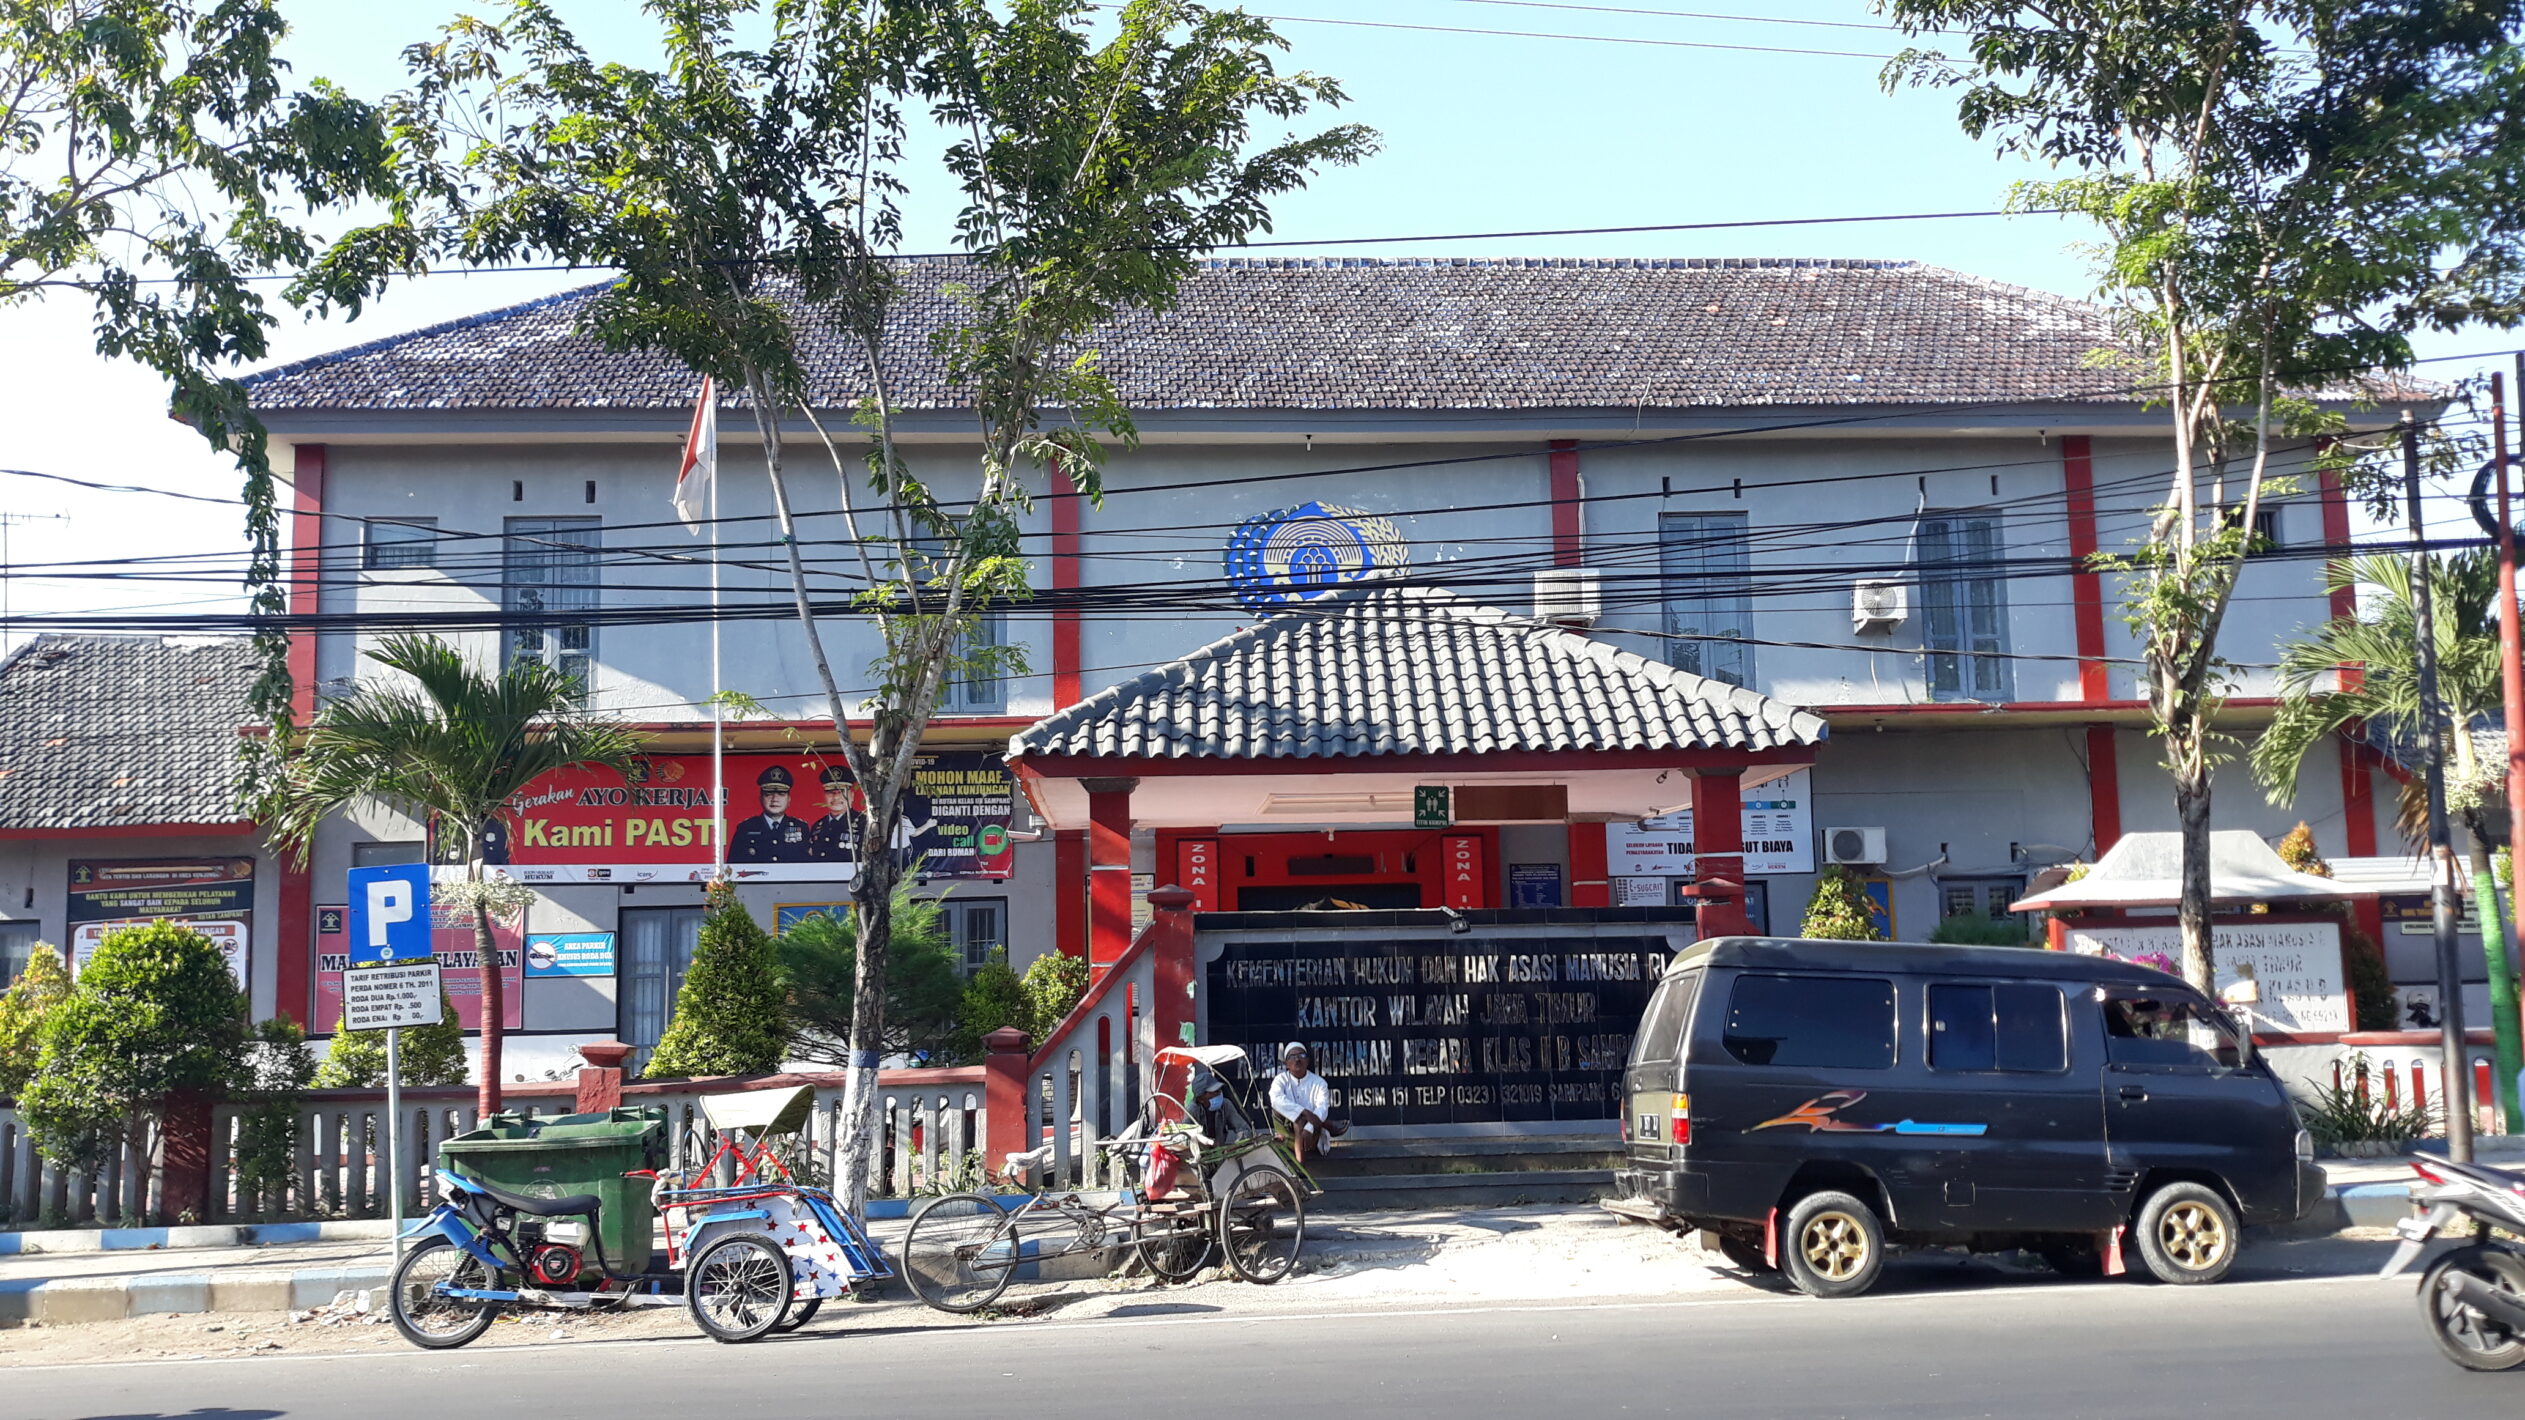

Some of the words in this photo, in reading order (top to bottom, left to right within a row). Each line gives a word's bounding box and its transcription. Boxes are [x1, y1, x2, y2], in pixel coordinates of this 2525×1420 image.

[916, 770, 964, 785] MOHON
[957, 785, 1010, 795] KUNJUNGAN
[512, 784, 575, 817] Gerakan
[576, 787, 628, 806] AYO
[931, 805, 971, 816] DIGANTI
[973, 805, 1010, 816] DENGAN
[524, 818, 613, 847] Kami
[937, 823, 969, 836] video
[953, 835, 975, 847] call
[1667, 842, 1695, 855] TIDA
[1762, 840, 1794, 853] BIAYA
[928, 848, 946, 857] DARI
[947, 848, 975, 856] RUMAH
[1191, 843, 1206, 886] ZONA
[1456, 840, 1471, 881] ZONA
[366, 880, 413, 947] P
[350, 973, 369, 982] TARIF
[371, 971, 406, 980] RETRIBUSI
[408, 969, 432, 977] PARKIR
[1226, 957, 1347, 989] KEMENTERIAN
[1353, 956, 1414, 985] HUKUM
[1422, 955, 1457, 984] DAN
[1464, 955, 1500, 984] HAK
[1508, 954, 1558, 983] ASASI
[1565, 953, 1641, 982] MANUSIA
[351, 984, 372, 992] PERDA
[374, 982, 398, 990] NOMER
[418, 980, 433, 988] 2011
[351, 995, 369, 1003] RODA
[351, 1005, 369, 1013] RODA
[371, 1003, 392, 1011] EMPAT
[1298, 996, 1376, 1029] KANTOR
[1387, 993, 1469, 1026] WILAYAH
[1480, 992, 1529, 1025] JAWA
[1534, 991, 1596, 1025] TIMUR
[352, 1016, 371, 1024] RODA
[1237, 1041, 1287, 1080] RUMA
[1310, 1039, 1392, 1077] TAHANAN
[1402, 1037, 1473, 1075] NEGARA
[1482, 1036, 1532, 1073] KLAS
[1556, 1034, 1571, 1072] B
[1577, 1033, 1632, 1070] SAMP
[1349, 1087, 1386, 1107] HASIM
[1391, 1086, 1409, 1106] 151
[1415, 1085, 1446, 1105] TELP
[1450, 1084, 1496, 1105] (0323)
[1502, 1083, 1542, 1103] 321019
[1549, 1082, 1605, 1102] SAMPANG
